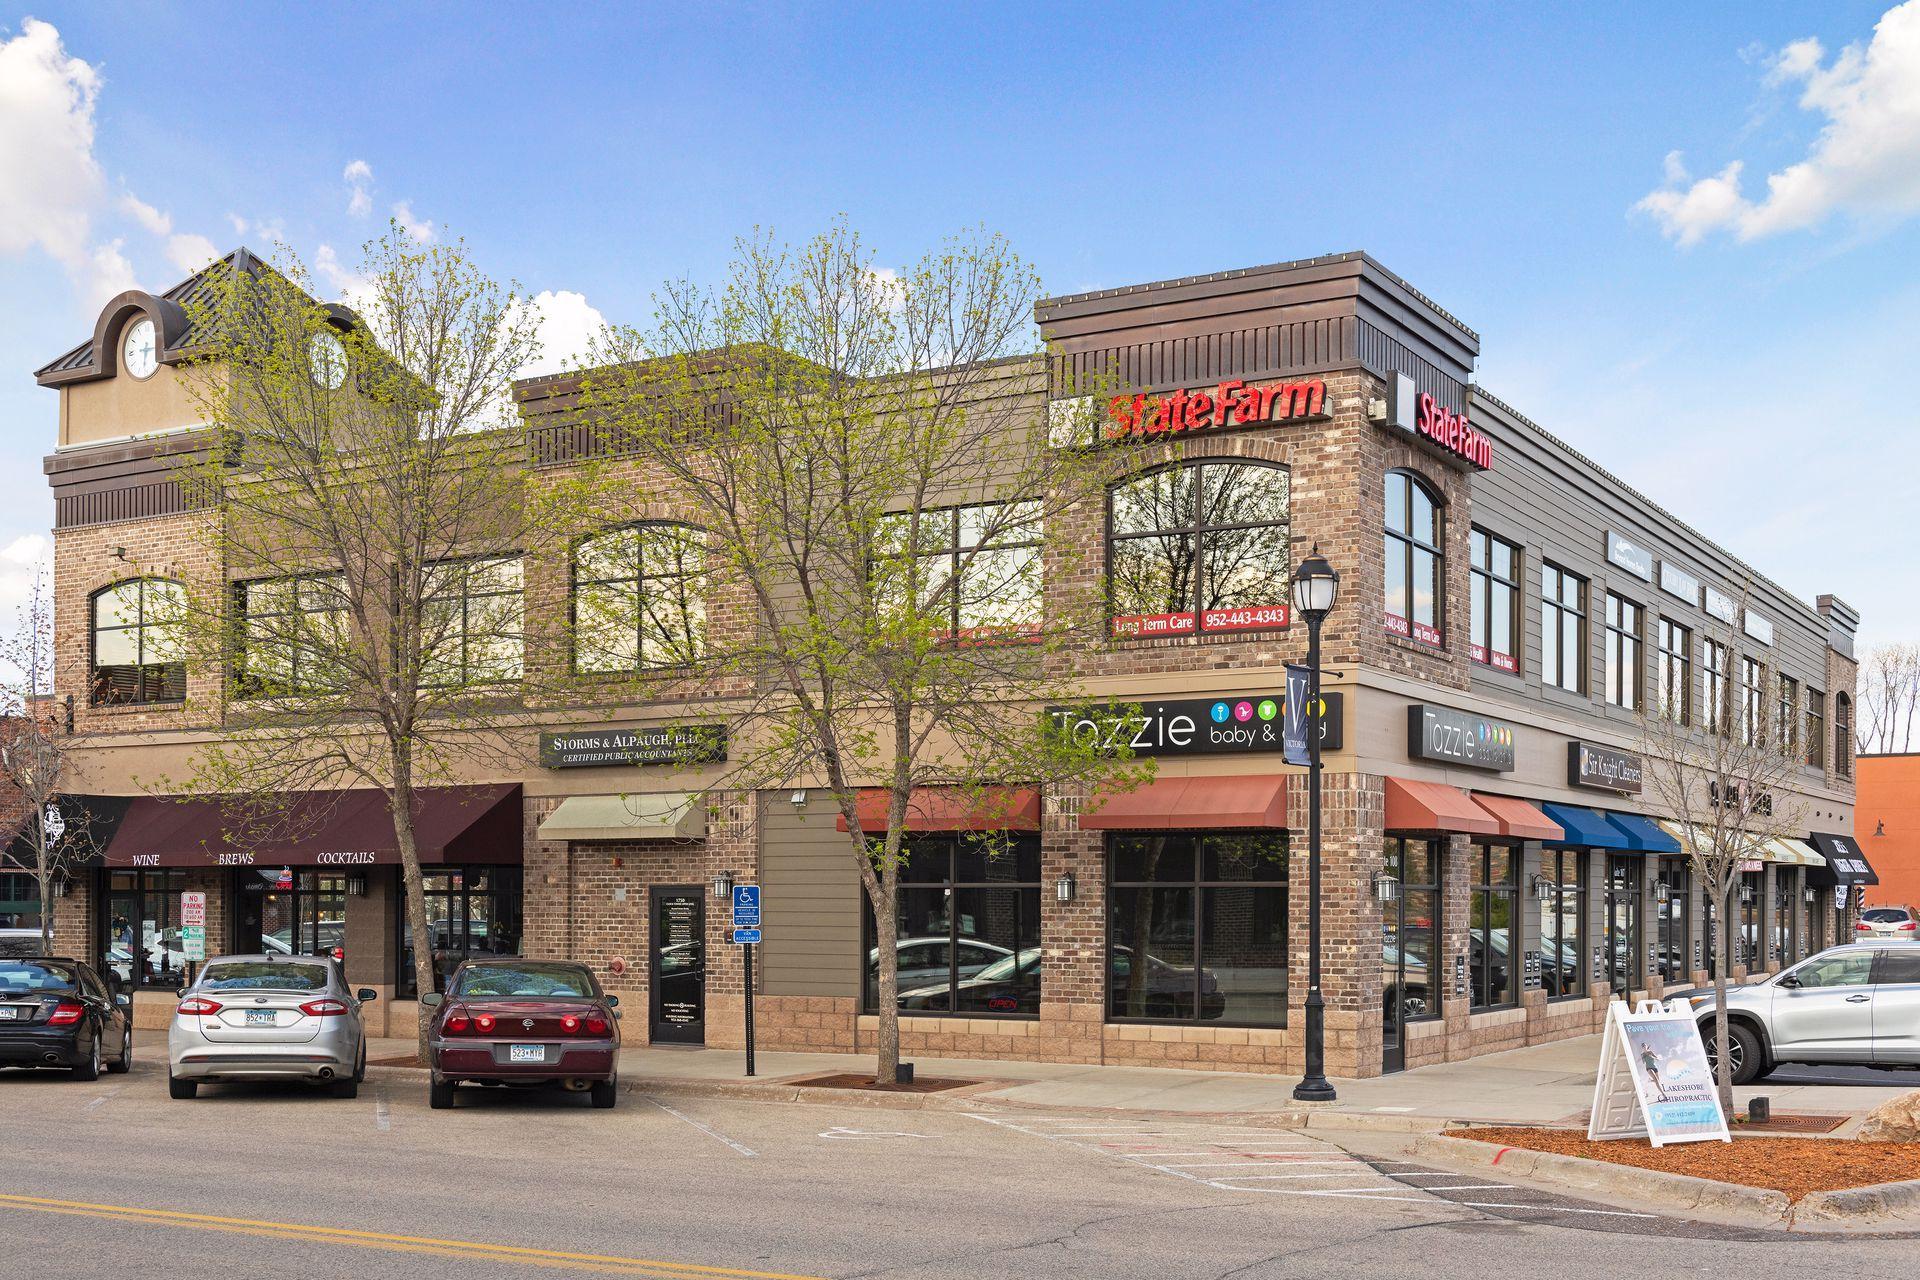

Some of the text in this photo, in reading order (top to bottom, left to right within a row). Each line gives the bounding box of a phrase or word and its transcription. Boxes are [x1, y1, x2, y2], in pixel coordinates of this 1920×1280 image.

[1115, 615, 1193, 634] Long Term Care
[1206, 609, 1284, 627] 952-443-4343
[1287, 677, 1307, 735] V
[1210, 725, 1256, 747] baby
[1262, 724, 1276, 741] &
[553, 737, 600, 751] STORMS
[602, 738, 610, 748] &
[612, 734, 672, 748] ALPAUGH,
[563, 753, 603, 763] CERTIFIED
[605, 751, 632, 761] PUBLIC
[1598, 755, 1617, 784] Knight
[133, 854, 160, 866] WINE
[218, 853, 254, 865] BREWS
[317, 851, 375, 864] COCKTAILS
[988, 1000, 1017, 1009] OPEN
[1661, 1083, 1704, 1092] LAKESHORE
[1657, 1094, 1713, 1103] CHIROPRACTIC
